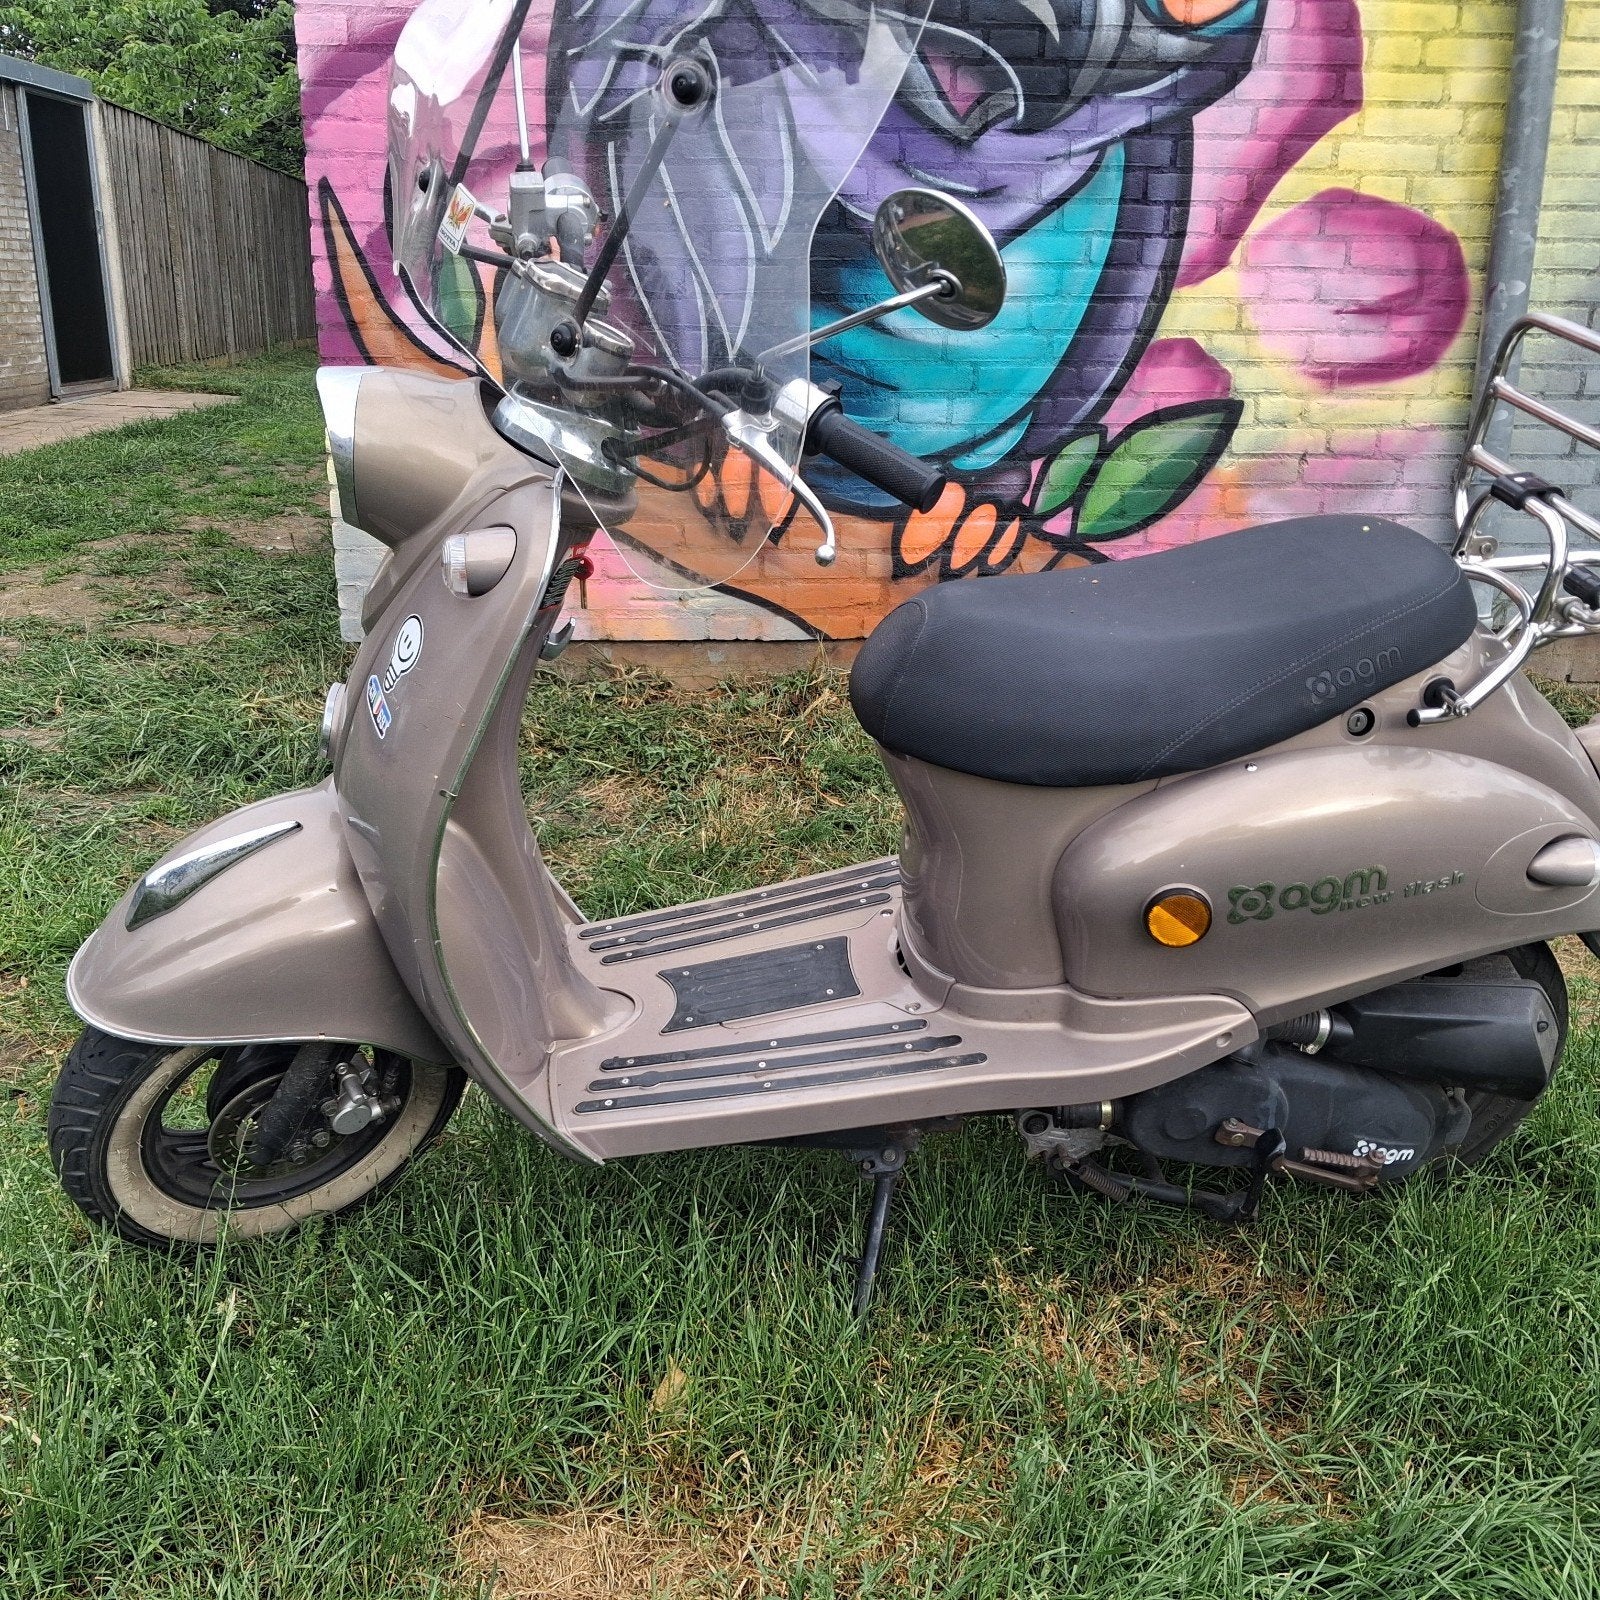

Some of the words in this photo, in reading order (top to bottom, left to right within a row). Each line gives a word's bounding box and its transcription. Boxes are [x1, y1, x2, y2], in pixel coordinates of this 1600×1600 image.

[1336, 646, 1402, 686] agm
[1279, 864, 1388, 915] agm
[1340, 890, 1394, 912] new
[1403, 870, 1465, 898] flash
